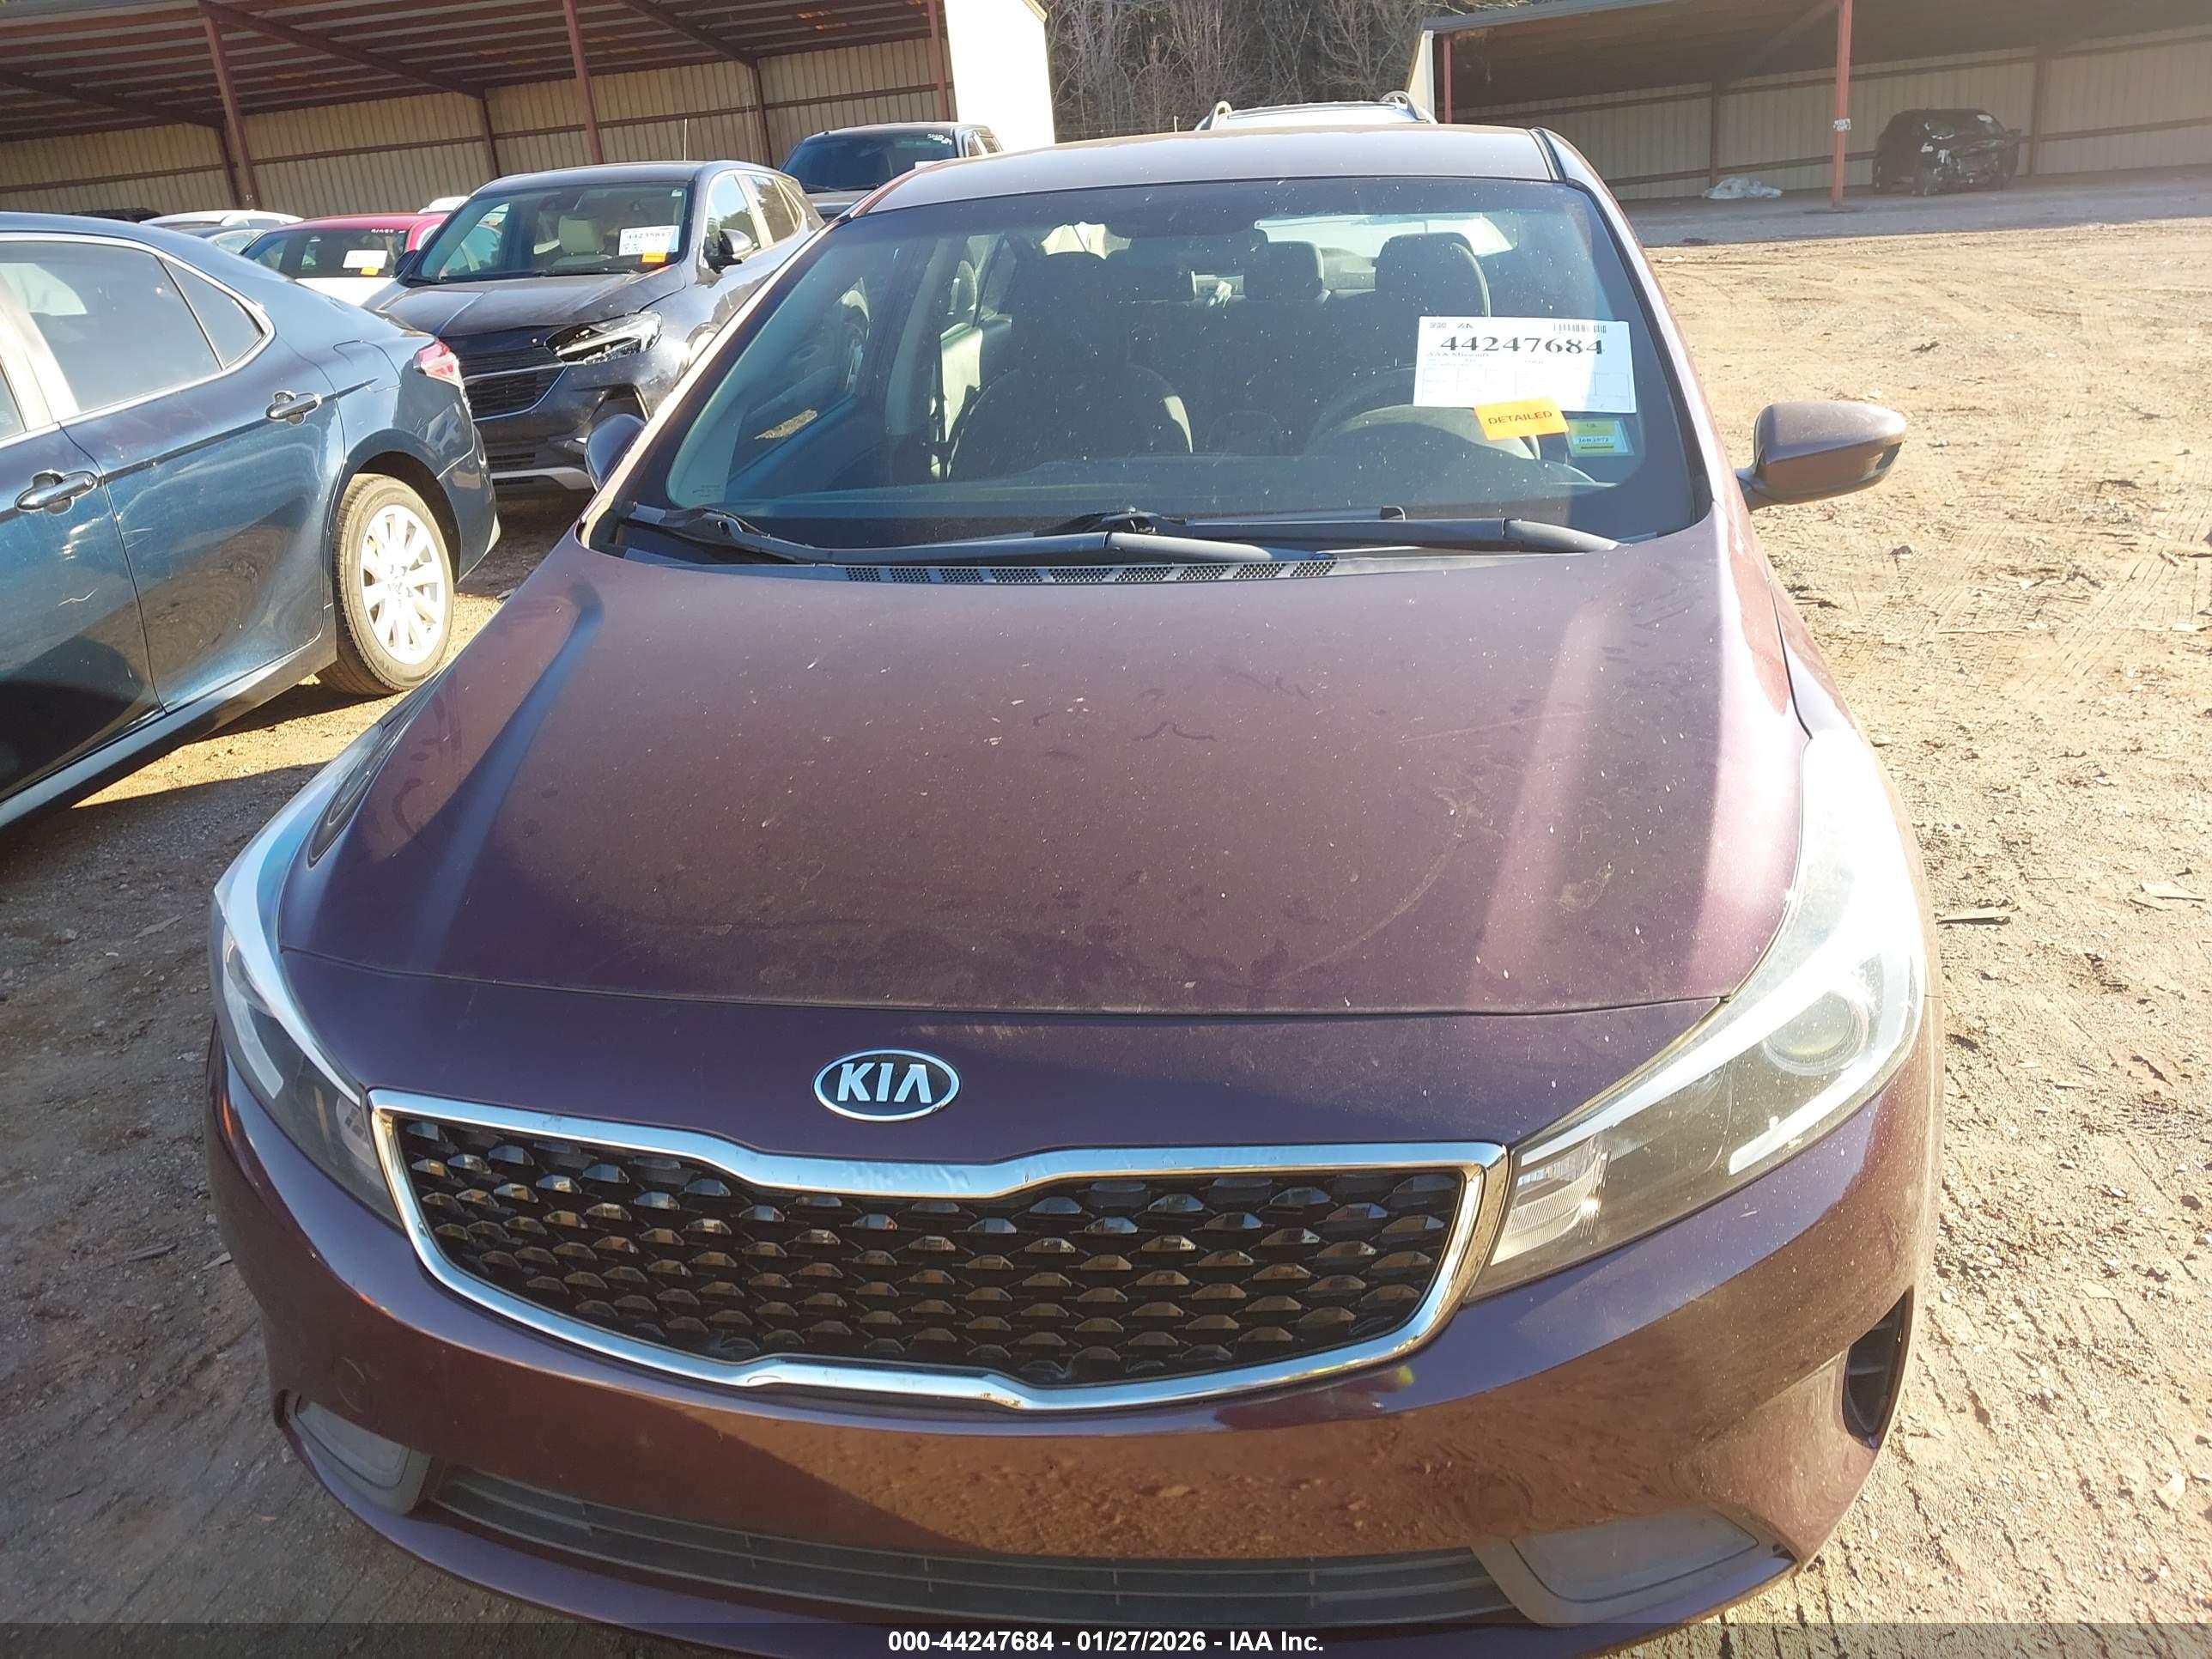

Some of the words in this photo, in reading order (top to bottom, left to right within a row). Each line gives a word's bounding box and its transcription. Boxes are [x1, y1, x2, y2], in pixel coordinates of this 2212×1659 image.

[1440, 336, 1604, 356] 44247684
[1488, 410, 1553, 426] DETAILED
[836, 1062, 933, 1103] KIA
